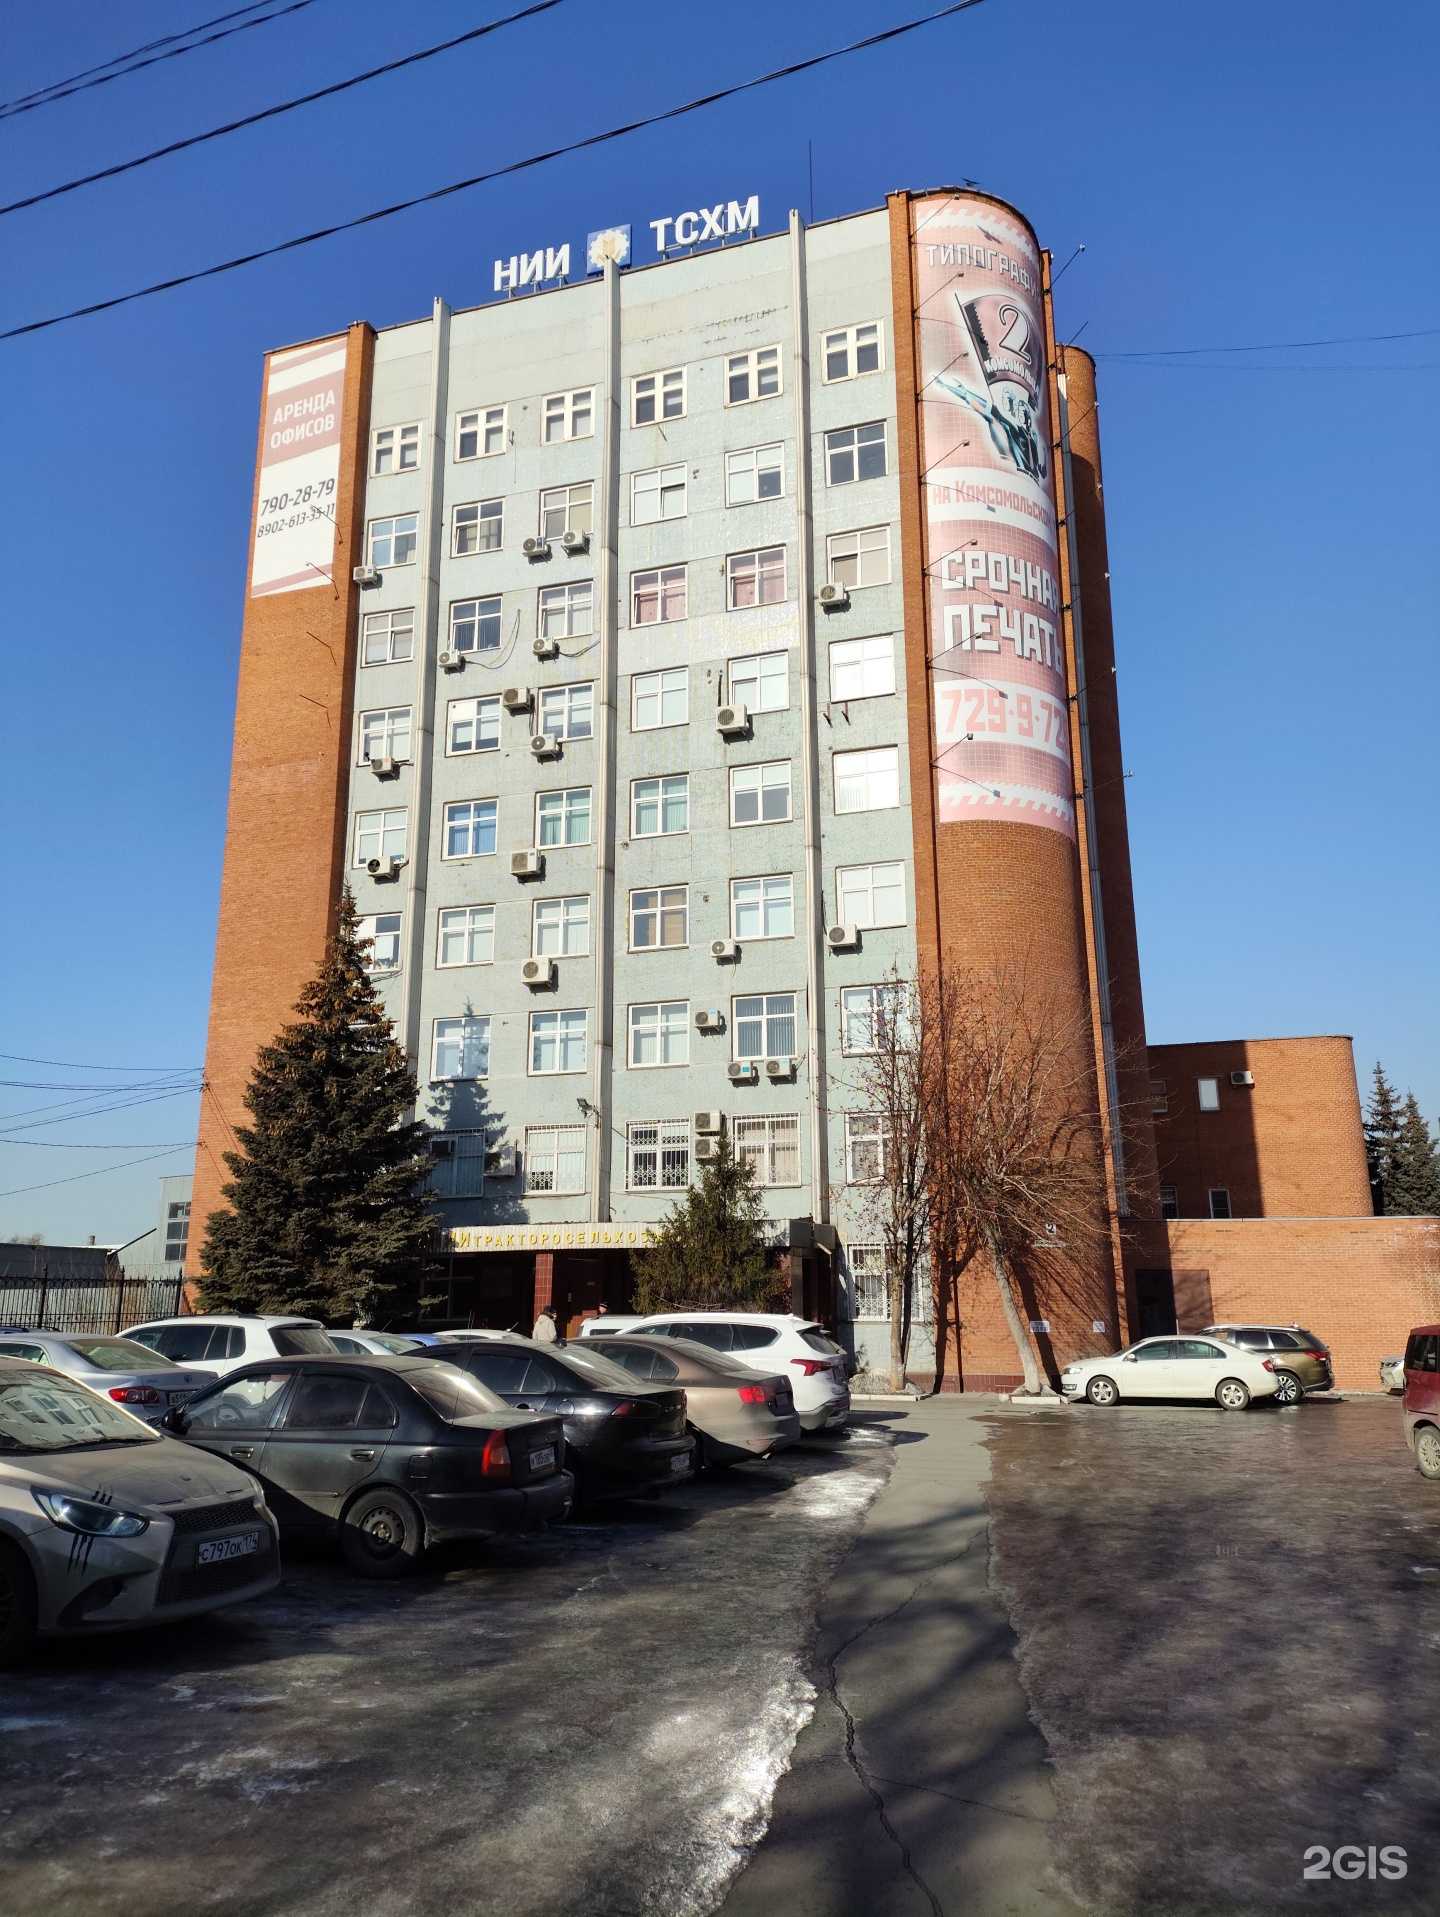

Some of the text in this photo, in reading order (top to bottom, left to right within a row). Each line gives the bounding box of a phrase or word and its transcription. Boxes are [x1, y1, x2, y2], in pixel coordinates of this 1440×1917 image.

[493, 195, 759, 292] НИИ ТСХМ
[272, 389, 336, 425] АРЕНДА
[270, 413, 335, 449] ОФИСОВ
[261, 477, 336, 516] 790-28-79
[943, 603, 1064, 674] ПЕЧАТЬ
